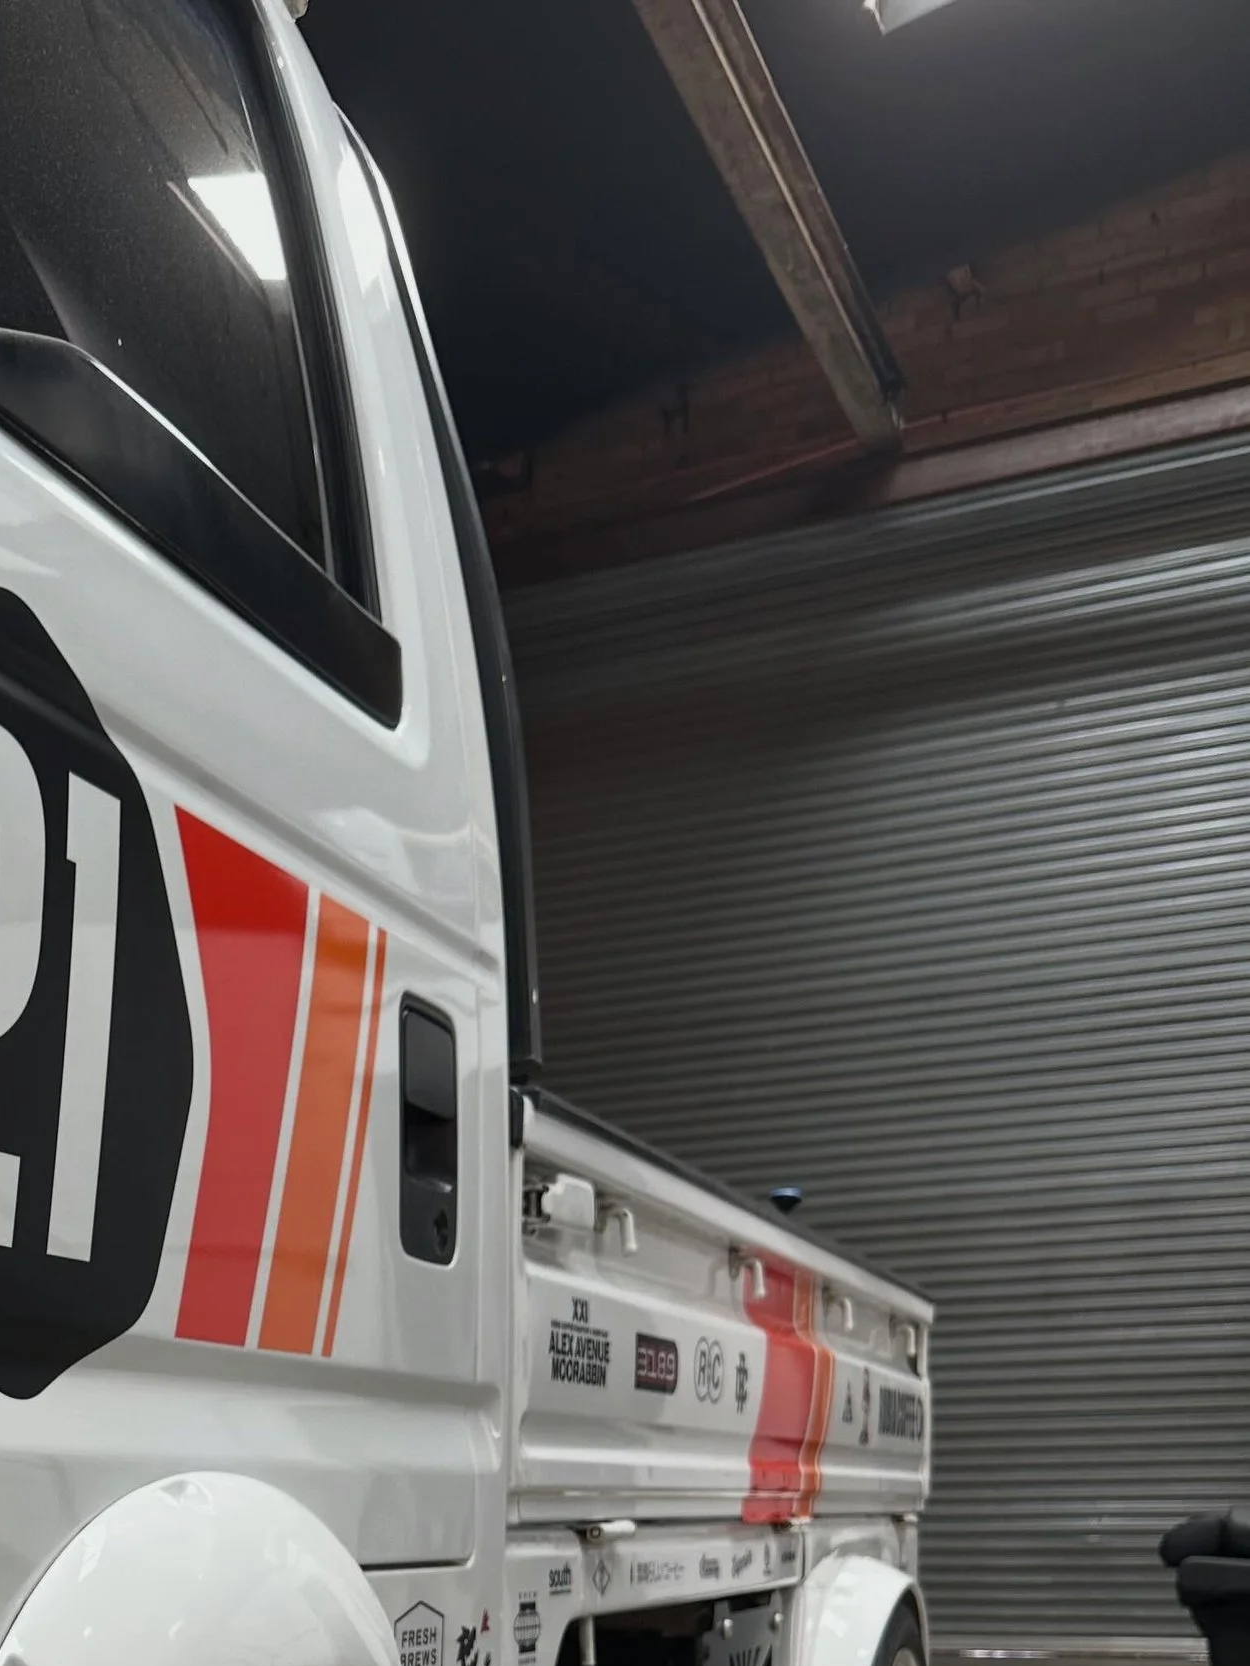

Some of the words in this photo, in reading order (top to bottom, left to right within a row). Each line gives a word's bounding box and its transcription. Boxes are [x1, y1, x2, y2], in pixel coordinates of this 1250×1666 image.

[572, 1296, 588, 1323] XXI
[549, 1328, 575, 1357] ALEX
[575, 1335, 610, 1364] AVENUE
[401, 1626, 437, 1649] FRESH
